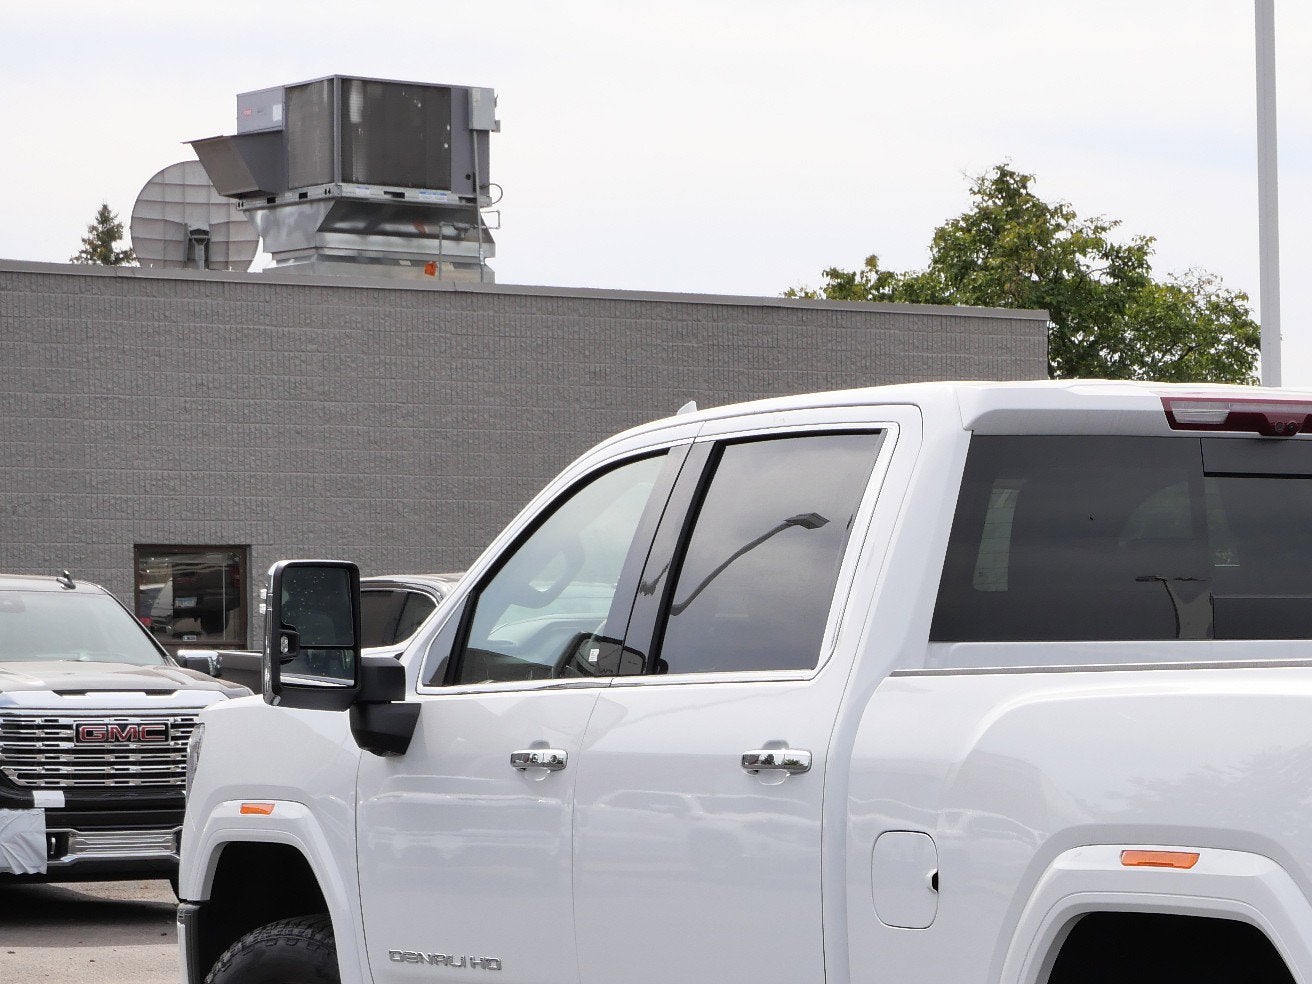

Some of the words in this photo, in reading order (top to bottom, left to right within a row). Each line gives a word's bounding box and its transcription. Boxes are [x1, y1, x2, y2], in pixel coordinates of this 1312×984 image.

[80, 725, 165, 741] GMC
[388, 949, 466, 968] DENALI
[469, 955, 502, 971] HD
